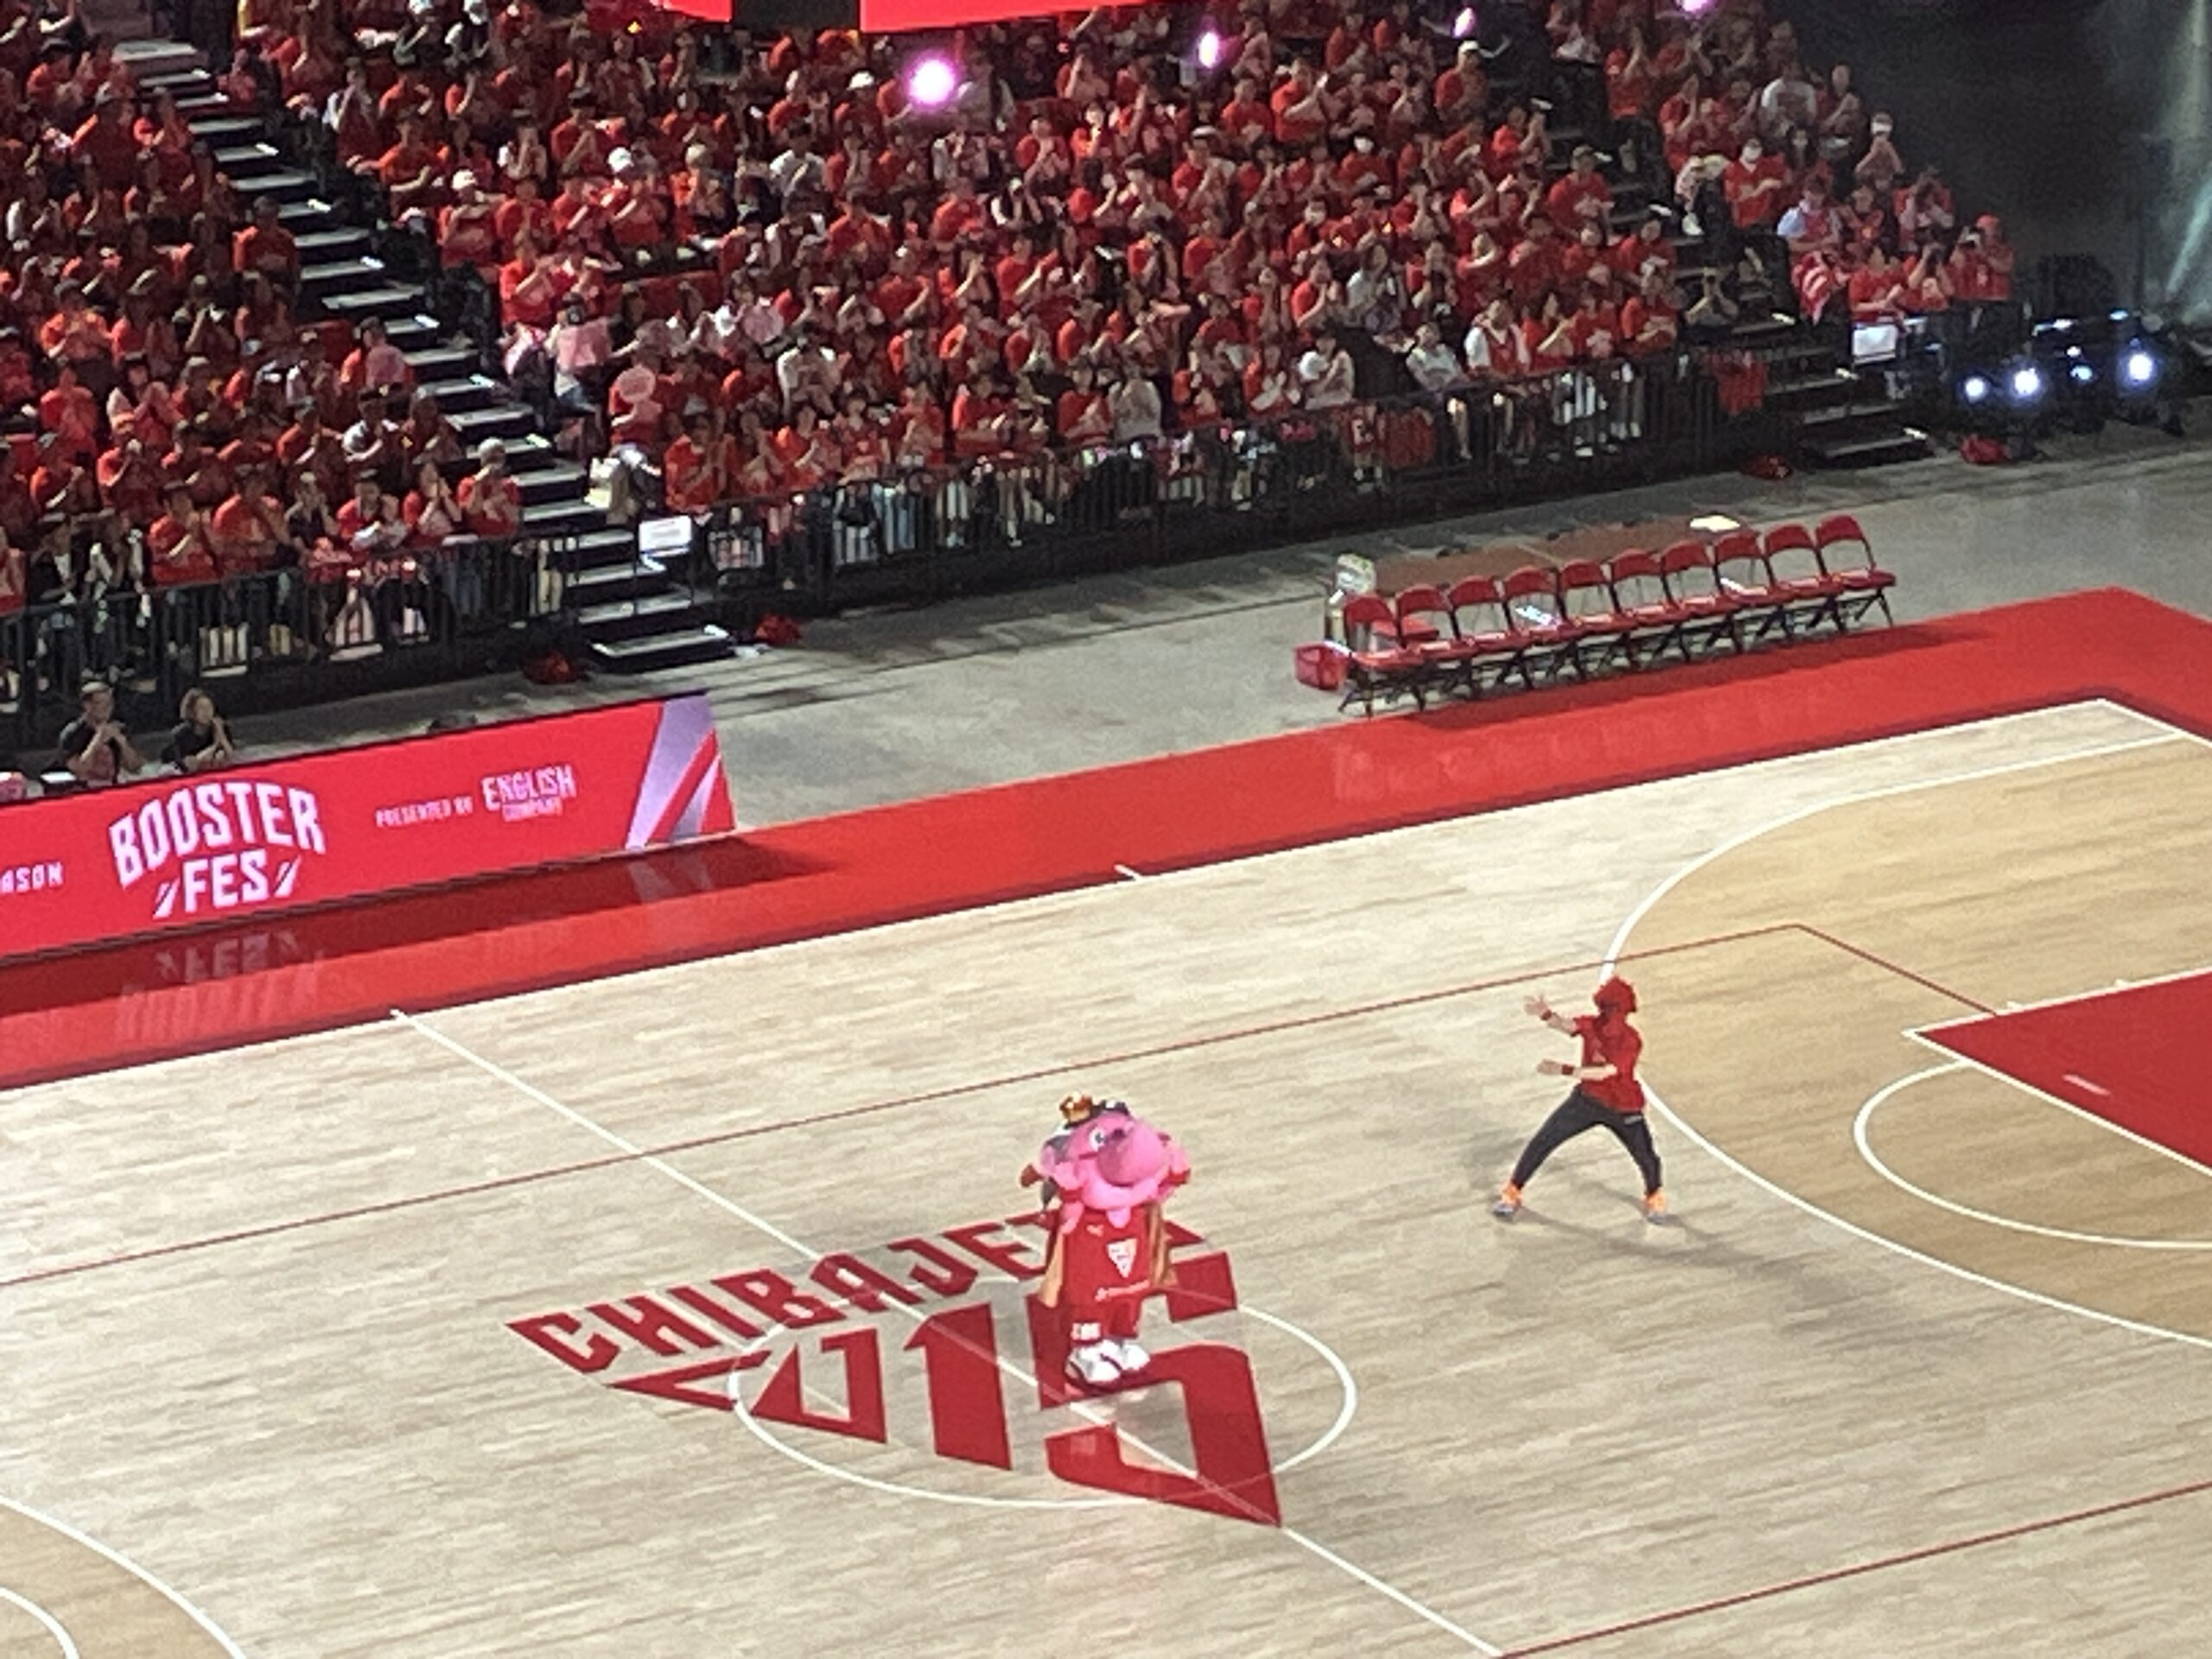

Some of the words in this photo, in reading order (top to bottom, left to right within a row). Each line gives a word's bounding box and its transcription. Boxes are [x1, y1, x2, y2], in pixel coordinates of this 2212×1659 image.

[480, 764, 577, 811] ENGLISH
[109, 782, 327, 888] BOOSTER
[0, 861, 64, 893] ASON
[182, 849, 270, 912] FES
[505, 1211, 1204, 1374] CHIBAJE
